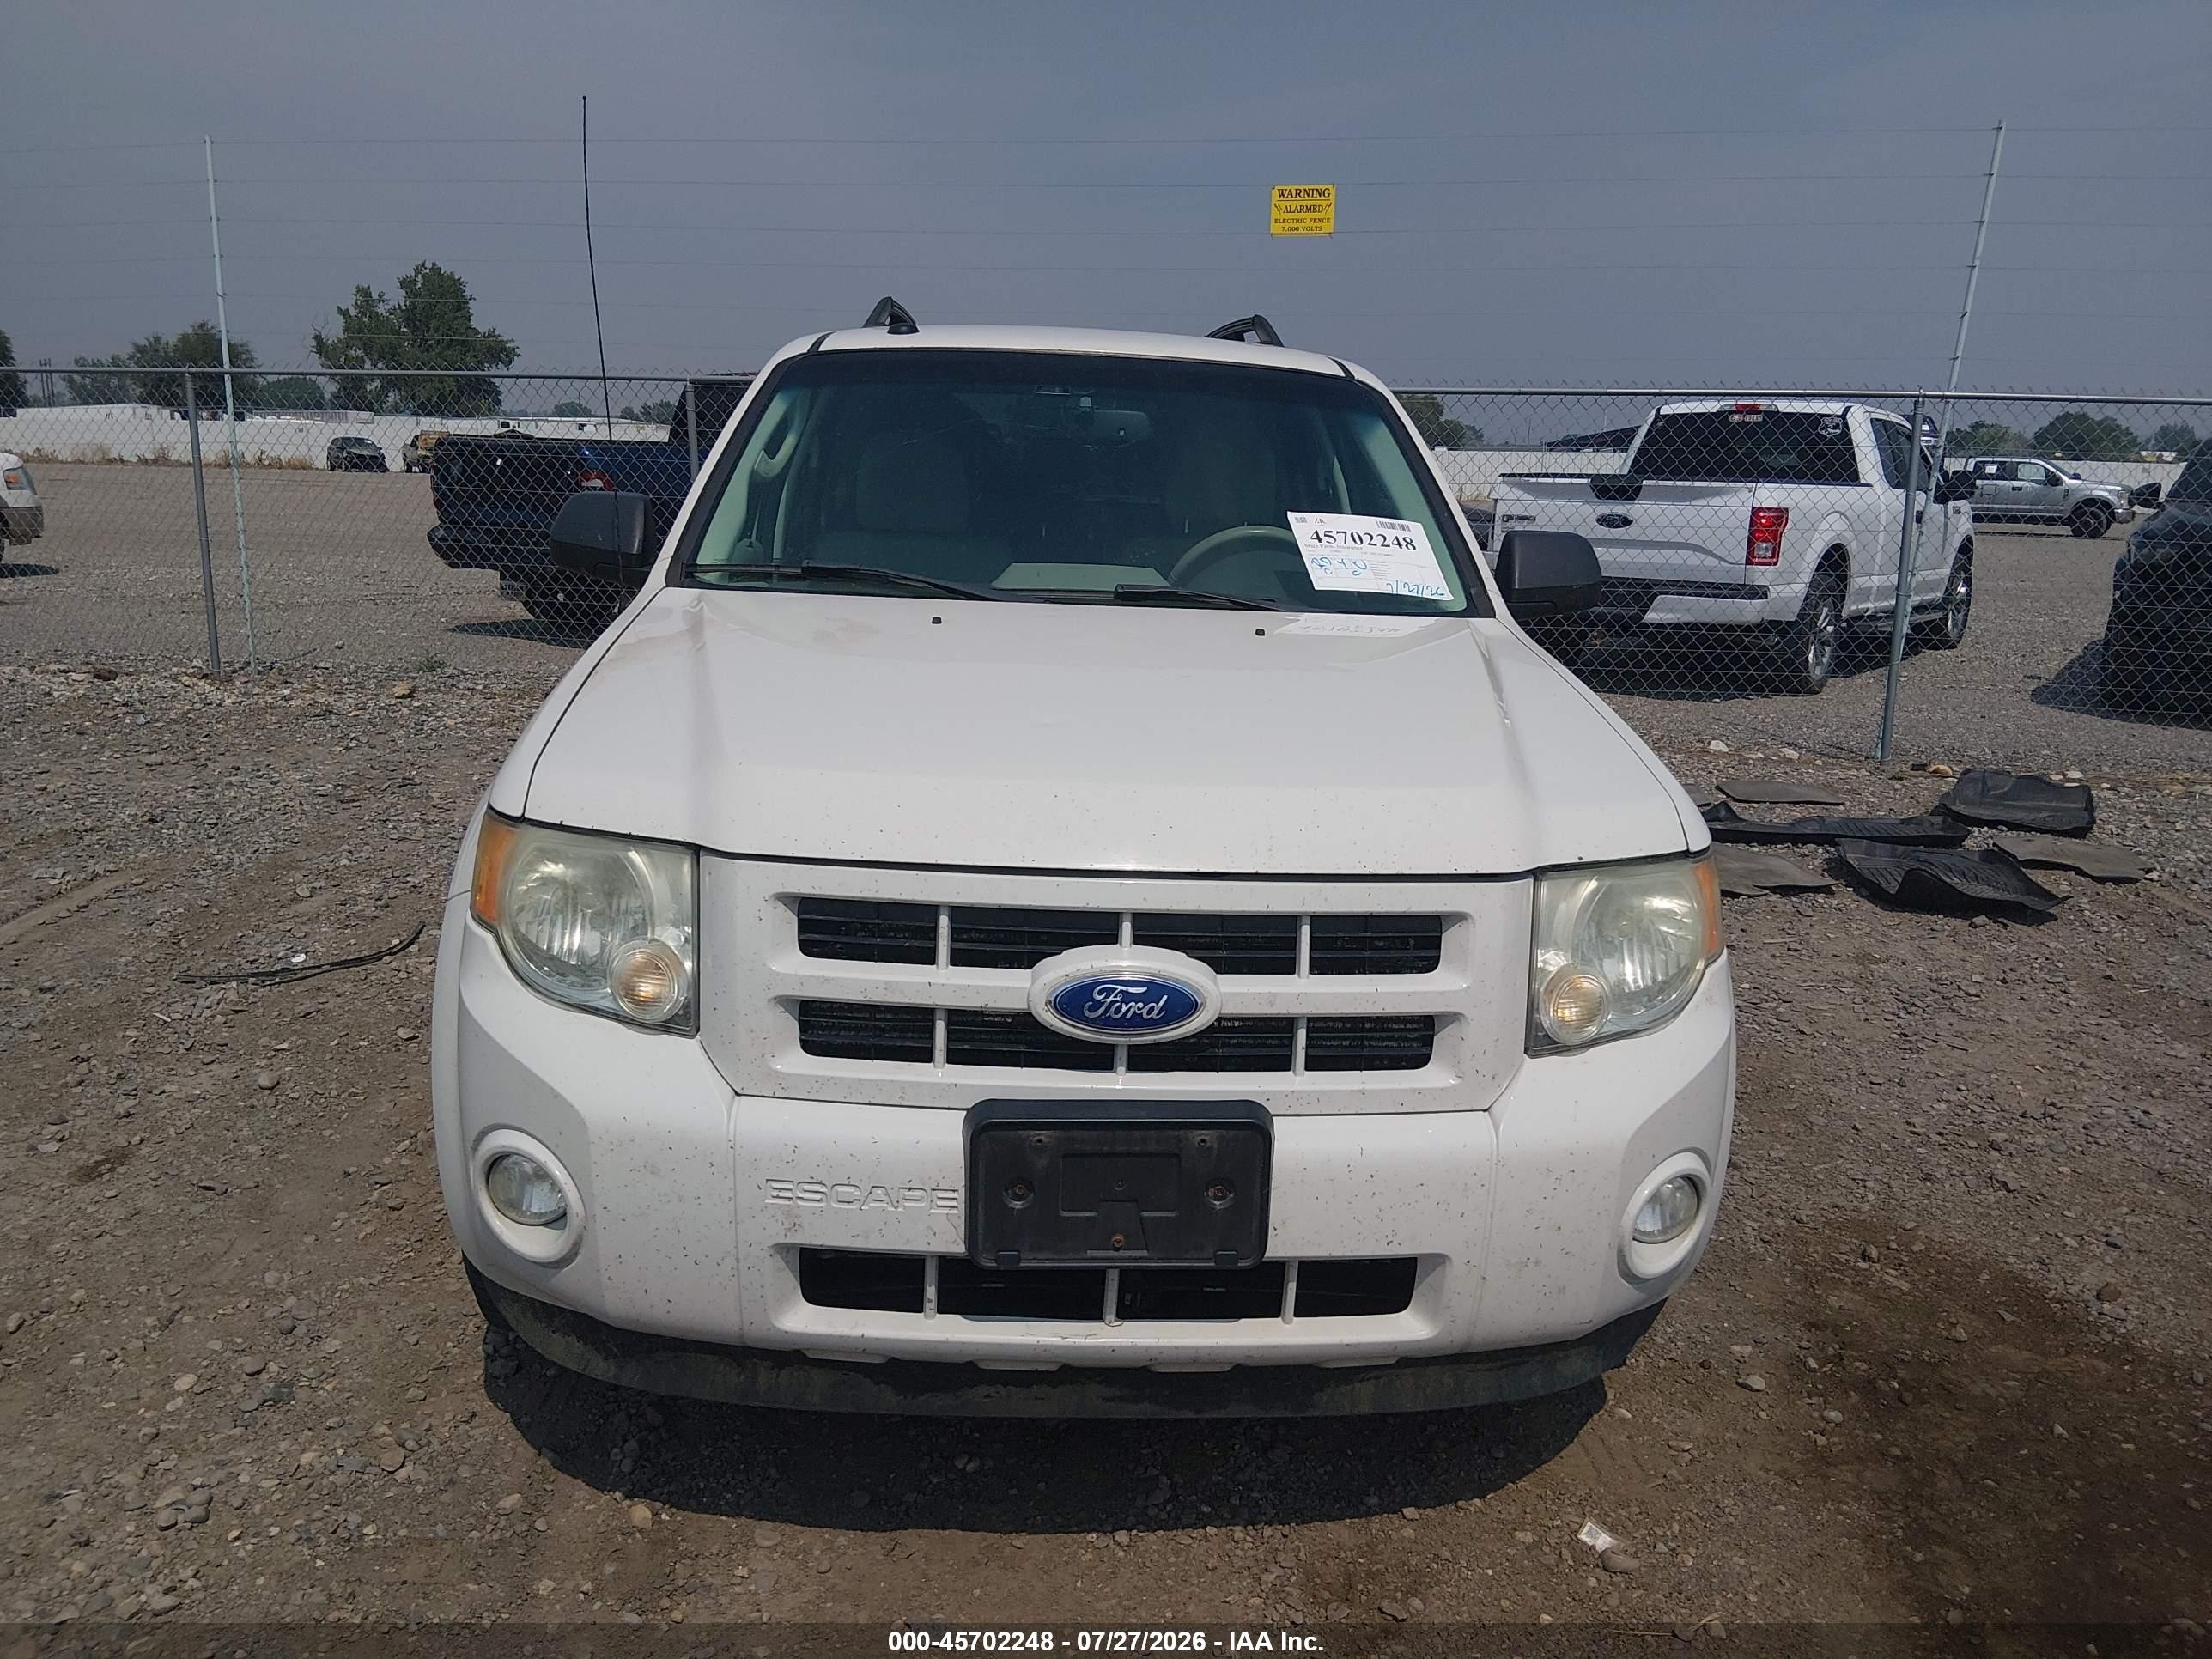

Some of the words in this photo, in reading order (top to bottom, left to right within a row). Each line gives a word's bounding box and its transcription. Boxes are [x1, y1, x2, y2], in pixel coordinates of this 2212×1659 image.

[1277, 188, 1331, 199] WARNING
[1283, 204, 1323, 214] ALARMED
[1310, 530, 1416, 550] 45702248
[1084, 984, 1169, 1020] Ford
[765, 1179, 959, 1214] ESCAPE
